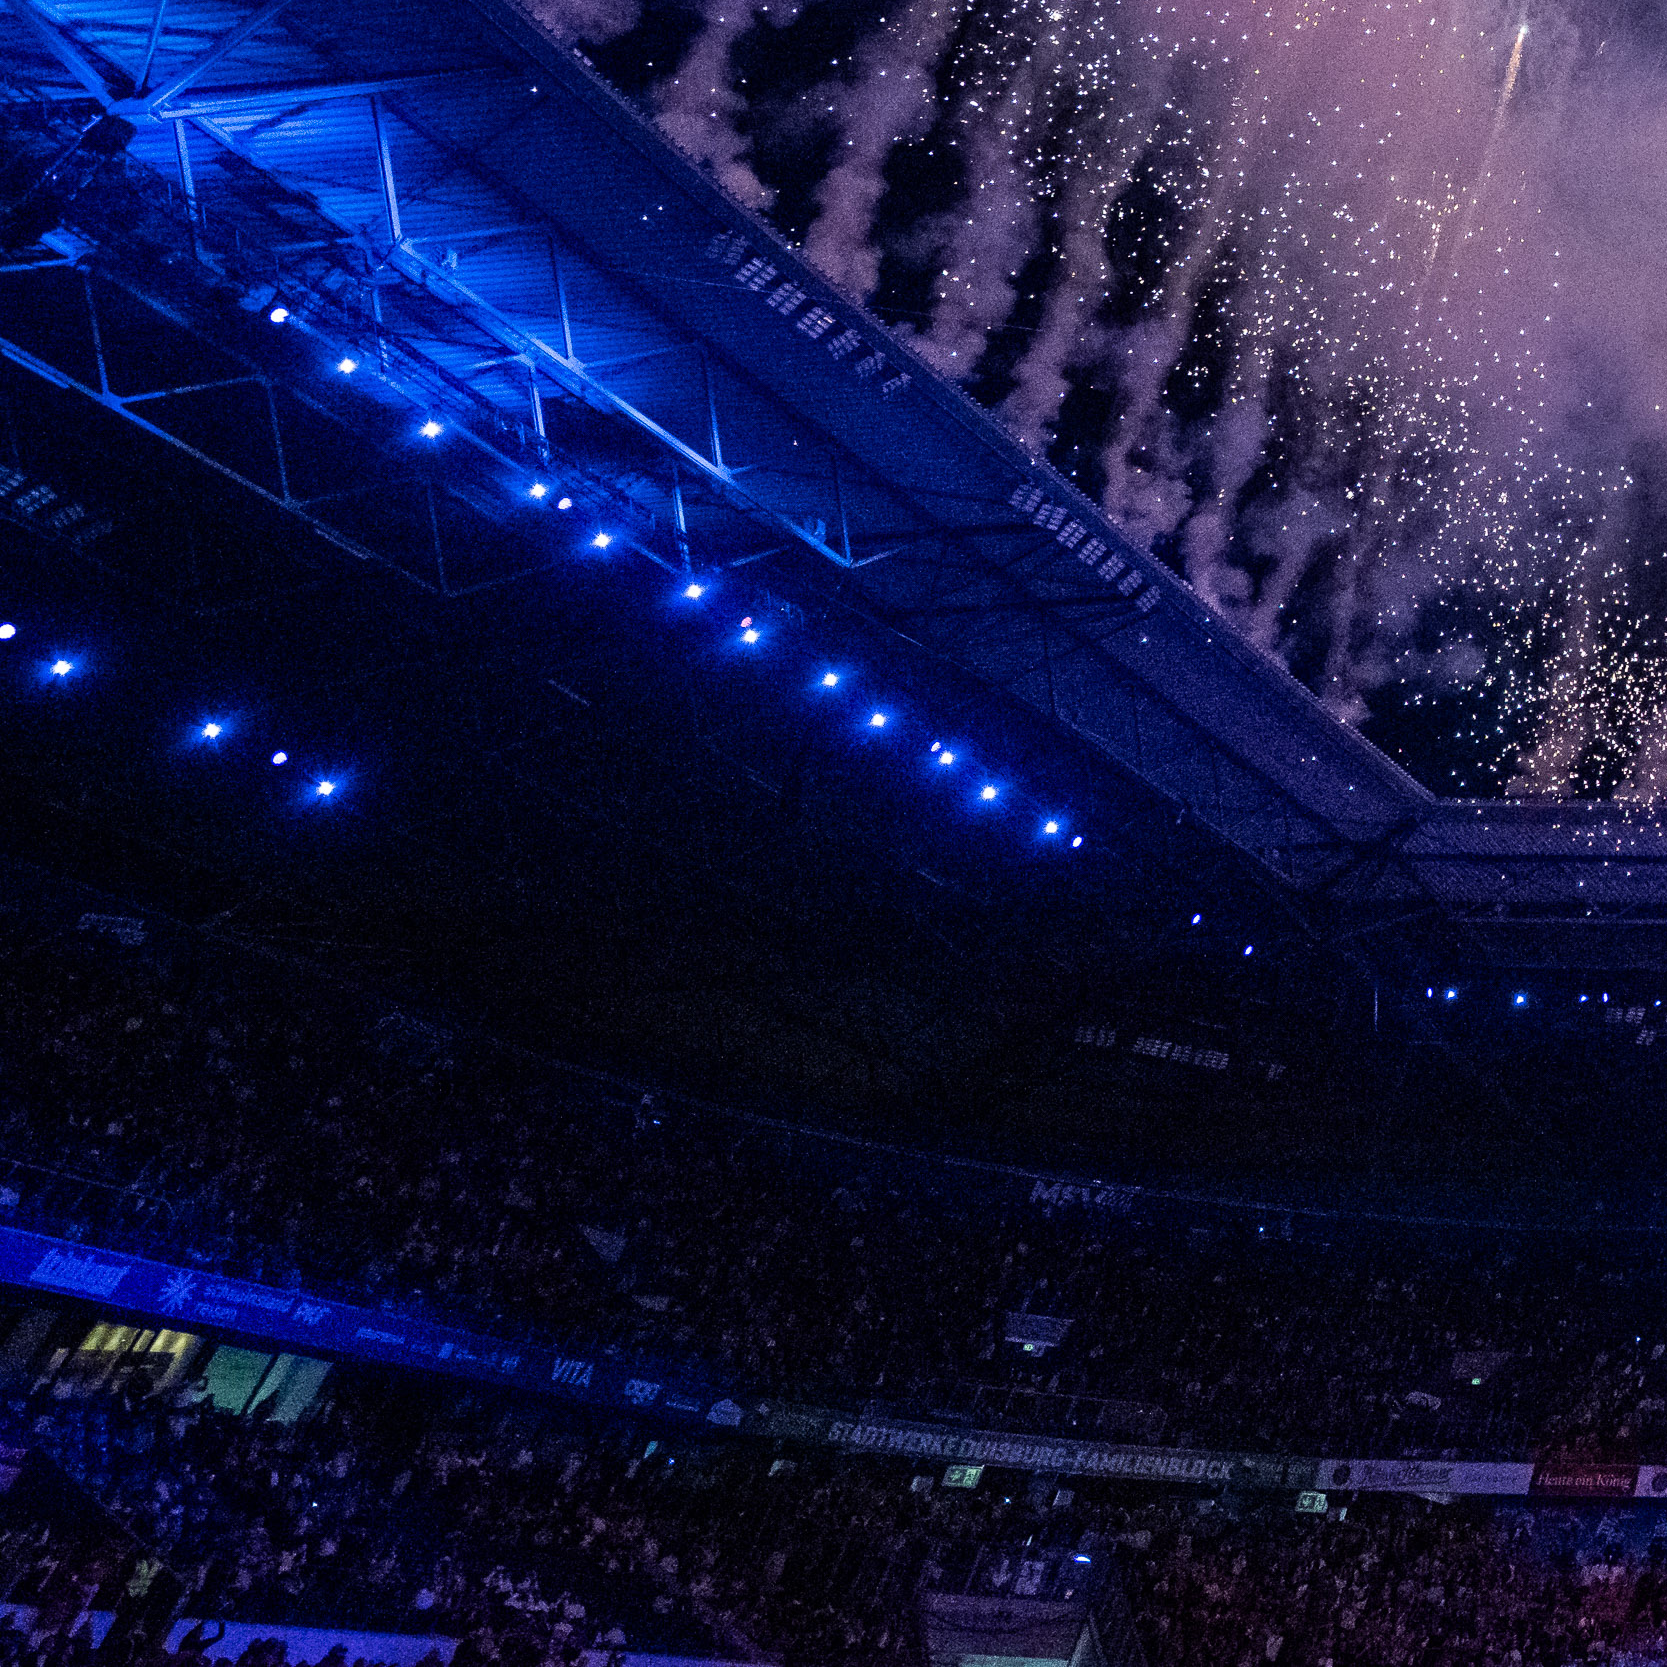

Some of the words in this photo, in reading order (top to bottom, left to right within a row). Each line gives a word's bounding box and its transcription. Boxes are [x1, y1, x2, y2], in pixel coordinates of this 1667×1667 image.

[550, 1355, 595, 1389] VITA
[827, 1420, 956, 1458] STADTWERKE
[1537, 1471, 1573, 1486] Heute
[1574, 1474, 1594, 1488] ein
[1595, 1472, 1632, 1492] König
